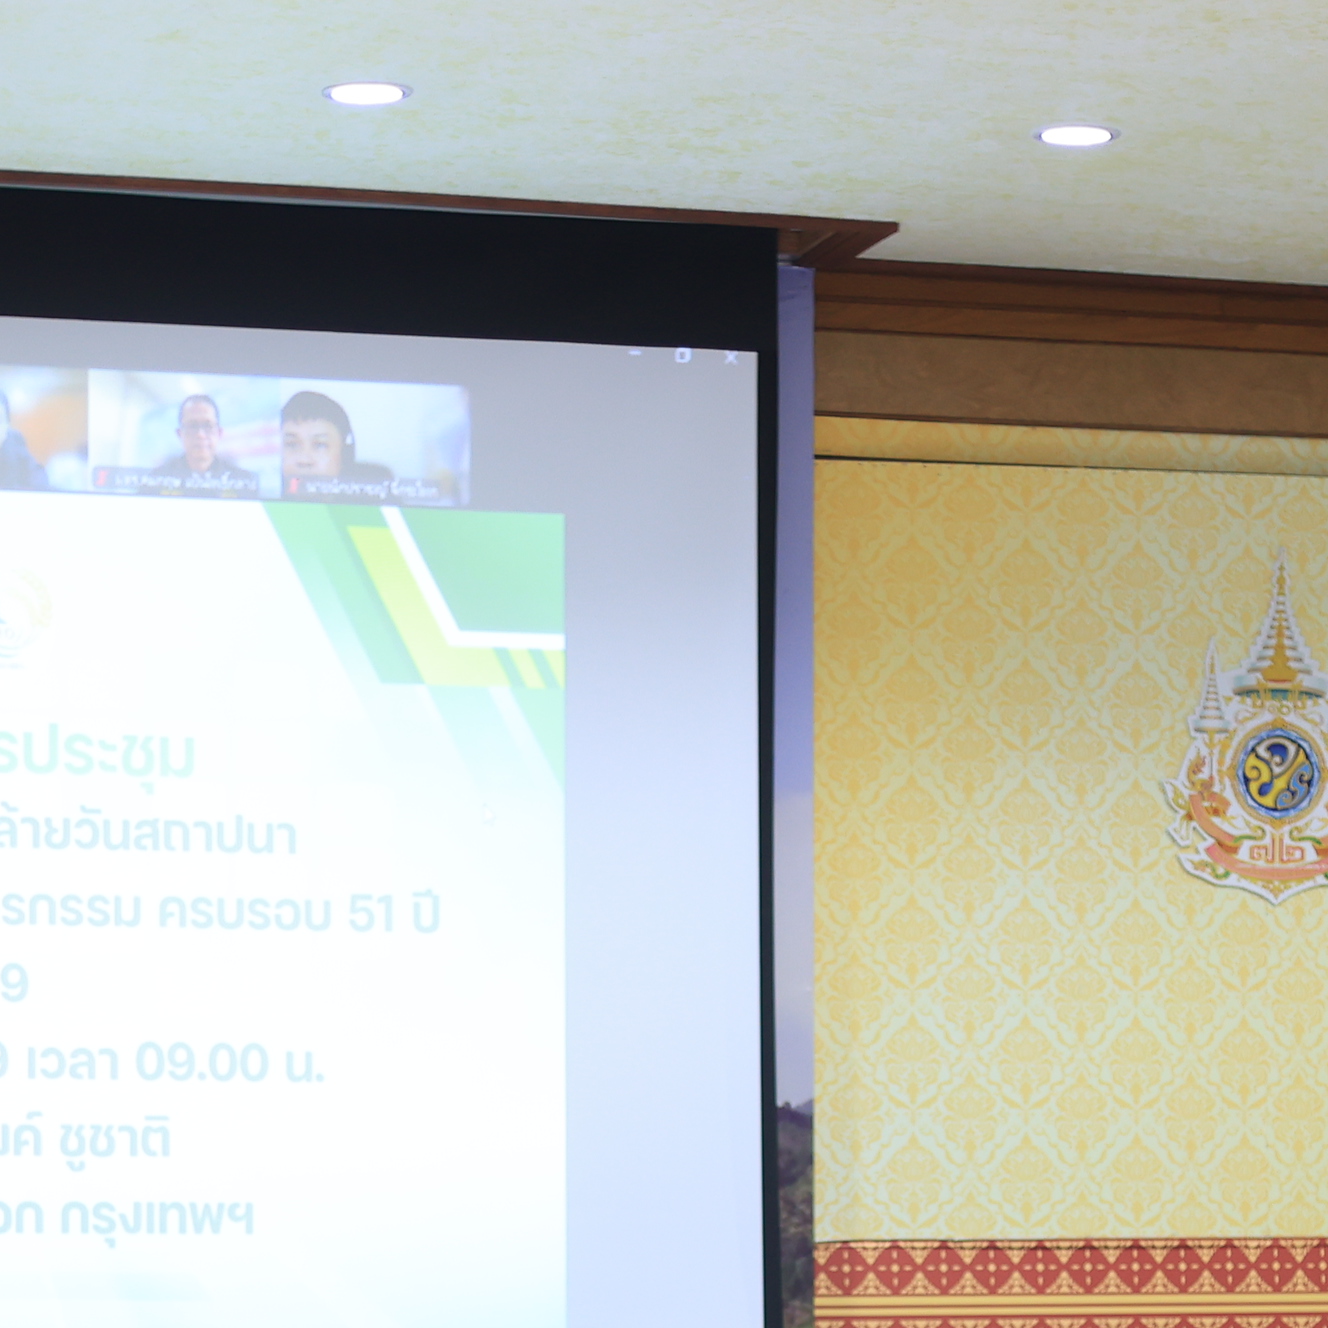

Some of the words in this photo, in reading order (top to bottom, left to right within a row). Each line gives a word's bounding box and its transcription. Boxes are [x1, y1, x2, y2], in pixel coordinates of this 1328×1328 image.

[159, 896, 331, 932] ครบรอบ
[349, 893, 393, 933] 51
[412, 888, 440, 934] ปี
[28, 1046, 119, 1080] เวลา
[135, 1041, 269, 1082] 09.00
[285, 1050, 325, 1083] น.
[60, 1115, 170, 1172] ชูชาติ
[61, 1201, 254, 1248] กรุงเทพฯ
